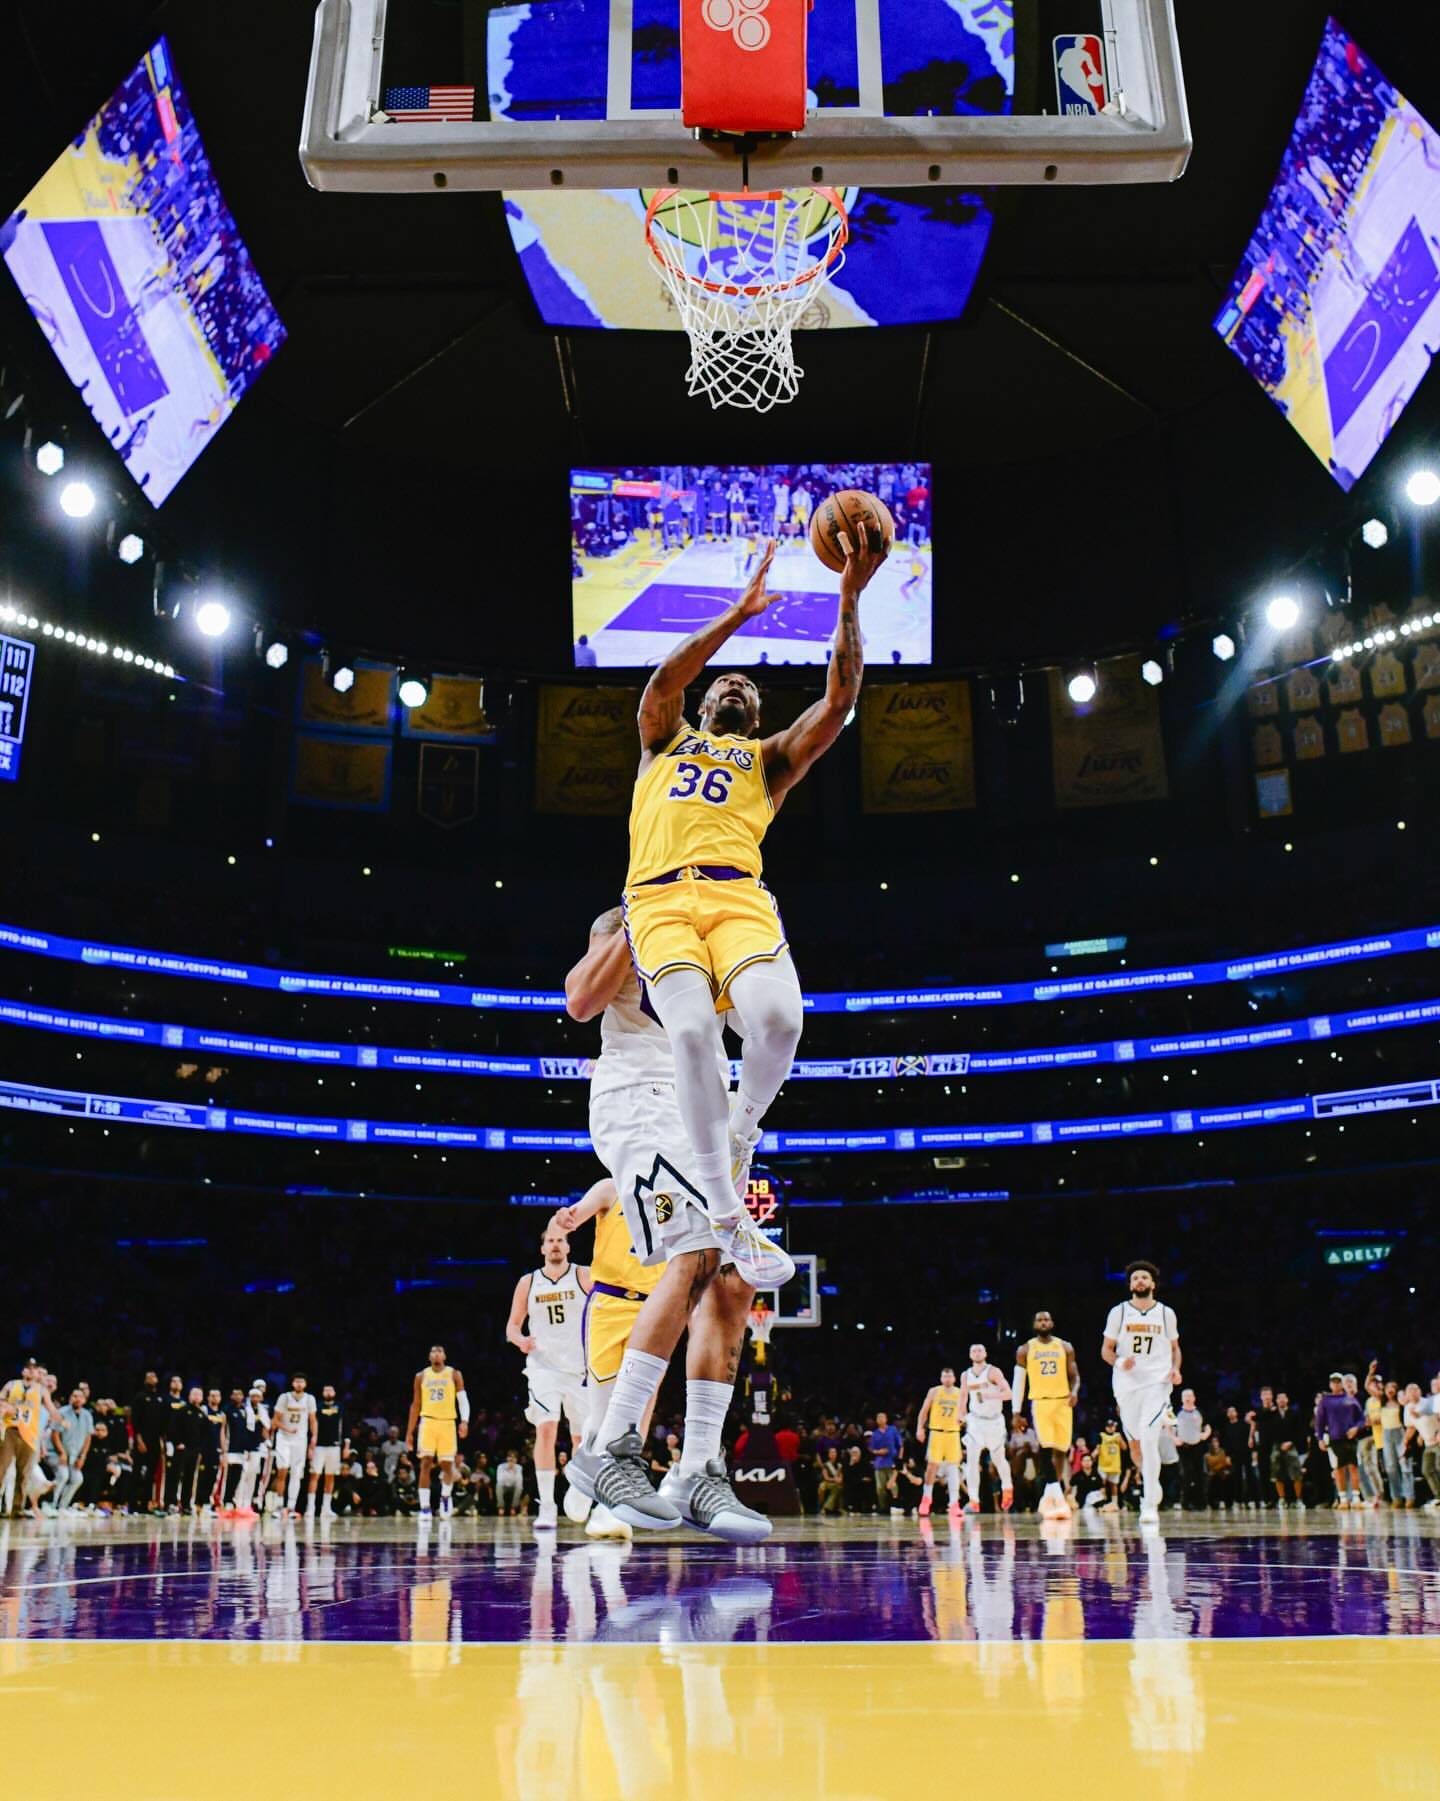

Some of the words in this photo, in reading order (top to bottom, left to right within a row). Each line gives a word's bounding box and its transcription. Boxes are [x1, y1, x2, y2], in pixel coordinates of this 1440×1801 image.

[6, 645, 26, 670] 111
[3, 672, 25, 697] 112
[665, 735, 756, 771] LAKERS
[669, 761, 735, 805] 36
[800, 1062, 844, 1077] Nuggets
[857, 1059, 890, 1077] 112
[547, 1304, 566, 1325] 15
[1133, 1336, 1154, 1355] 27
[1040, 1361, 1058, 1376] 23
[941, 1406, 955, 1418] 77
[735, 1468, 787, 1483] KIA
